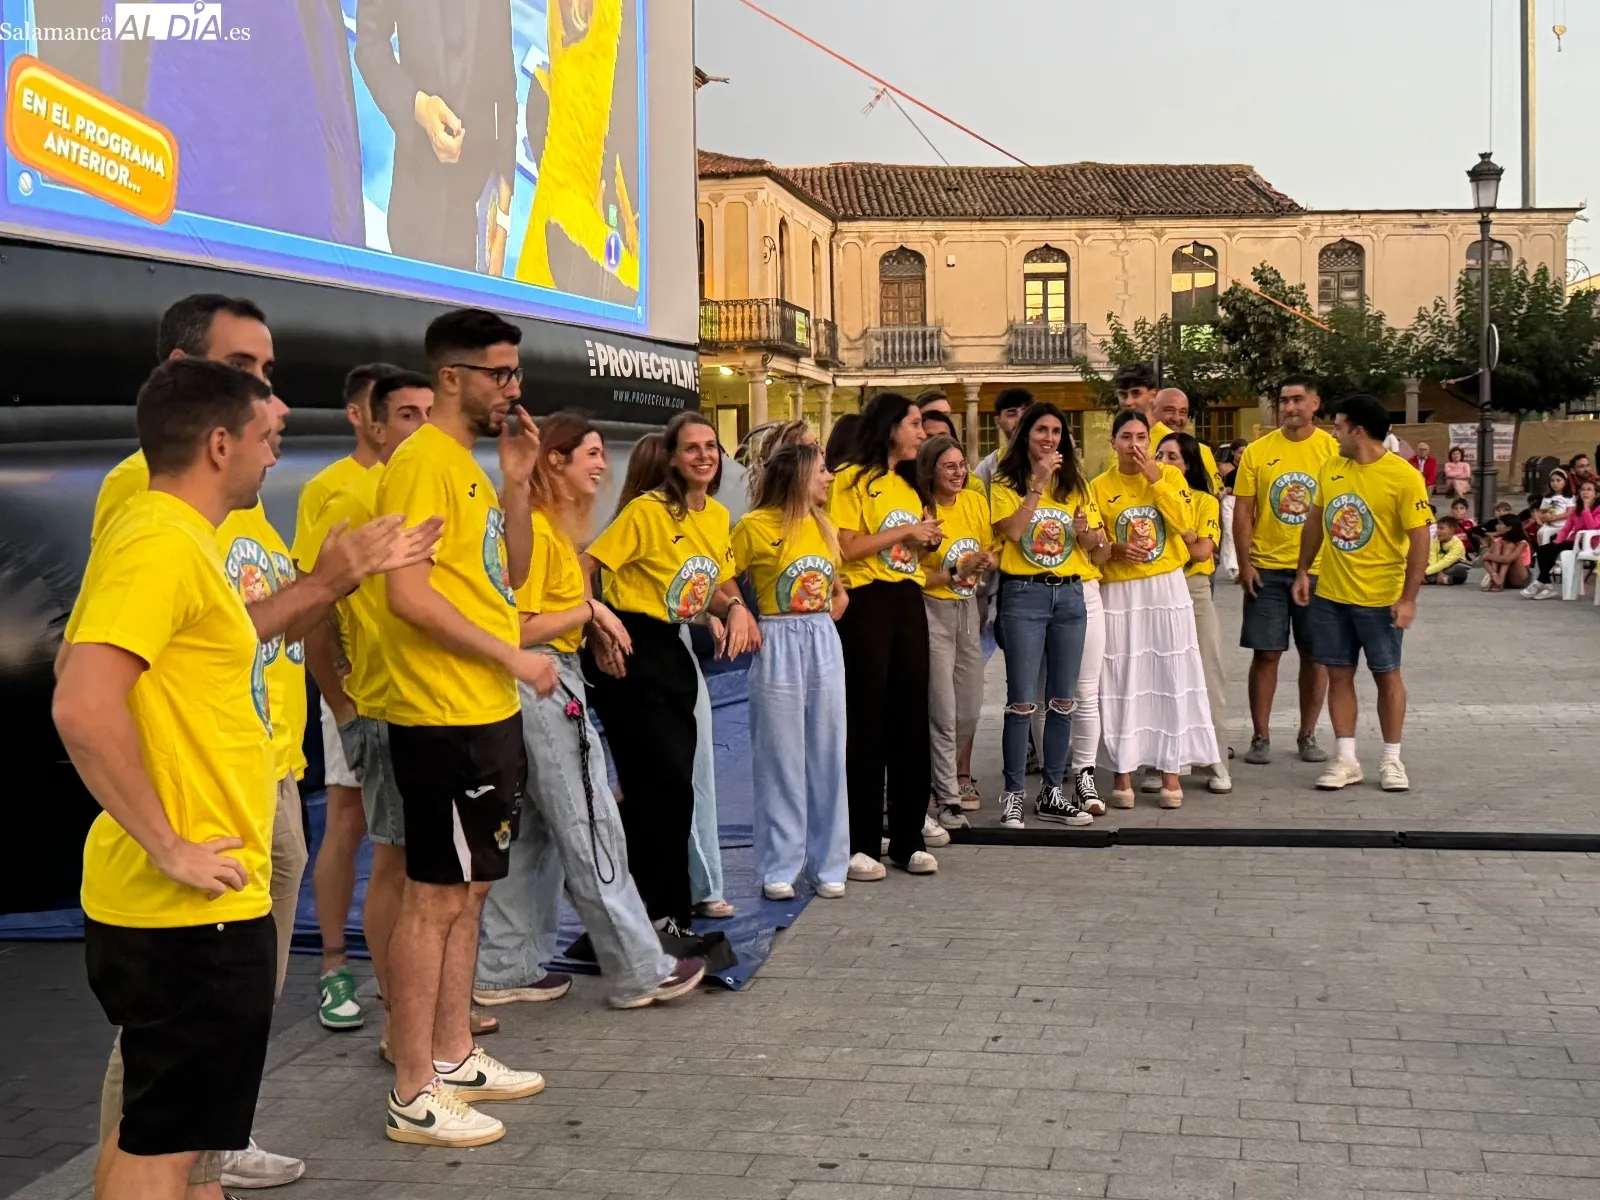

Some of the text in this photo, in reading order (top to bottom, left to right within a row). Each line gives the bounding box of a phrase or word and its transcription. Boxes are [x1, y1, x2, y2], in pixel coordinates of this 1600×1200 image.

[22, 87, 166, 178] EN EL PROGRAMA
[43, 131, 142, 195] ANTERIOR...
[595, 342, 695, 391] PROYECFILM
[1276, 472, 1316, 489] GRAND
[1332, 494, 1368, 515] GRAND
[1118, 505, 1158, 526] GRAND
[1281, 513, 1307, 523] PRIX
[1332, 536, 1359, 550] PRIX
[228, 541, 268, 578] GRAND
[680, 557, 718, 580] GRAND
[786, 556, 832, 577] GRAND
[1034, 553, 1063, 566] PRIX
